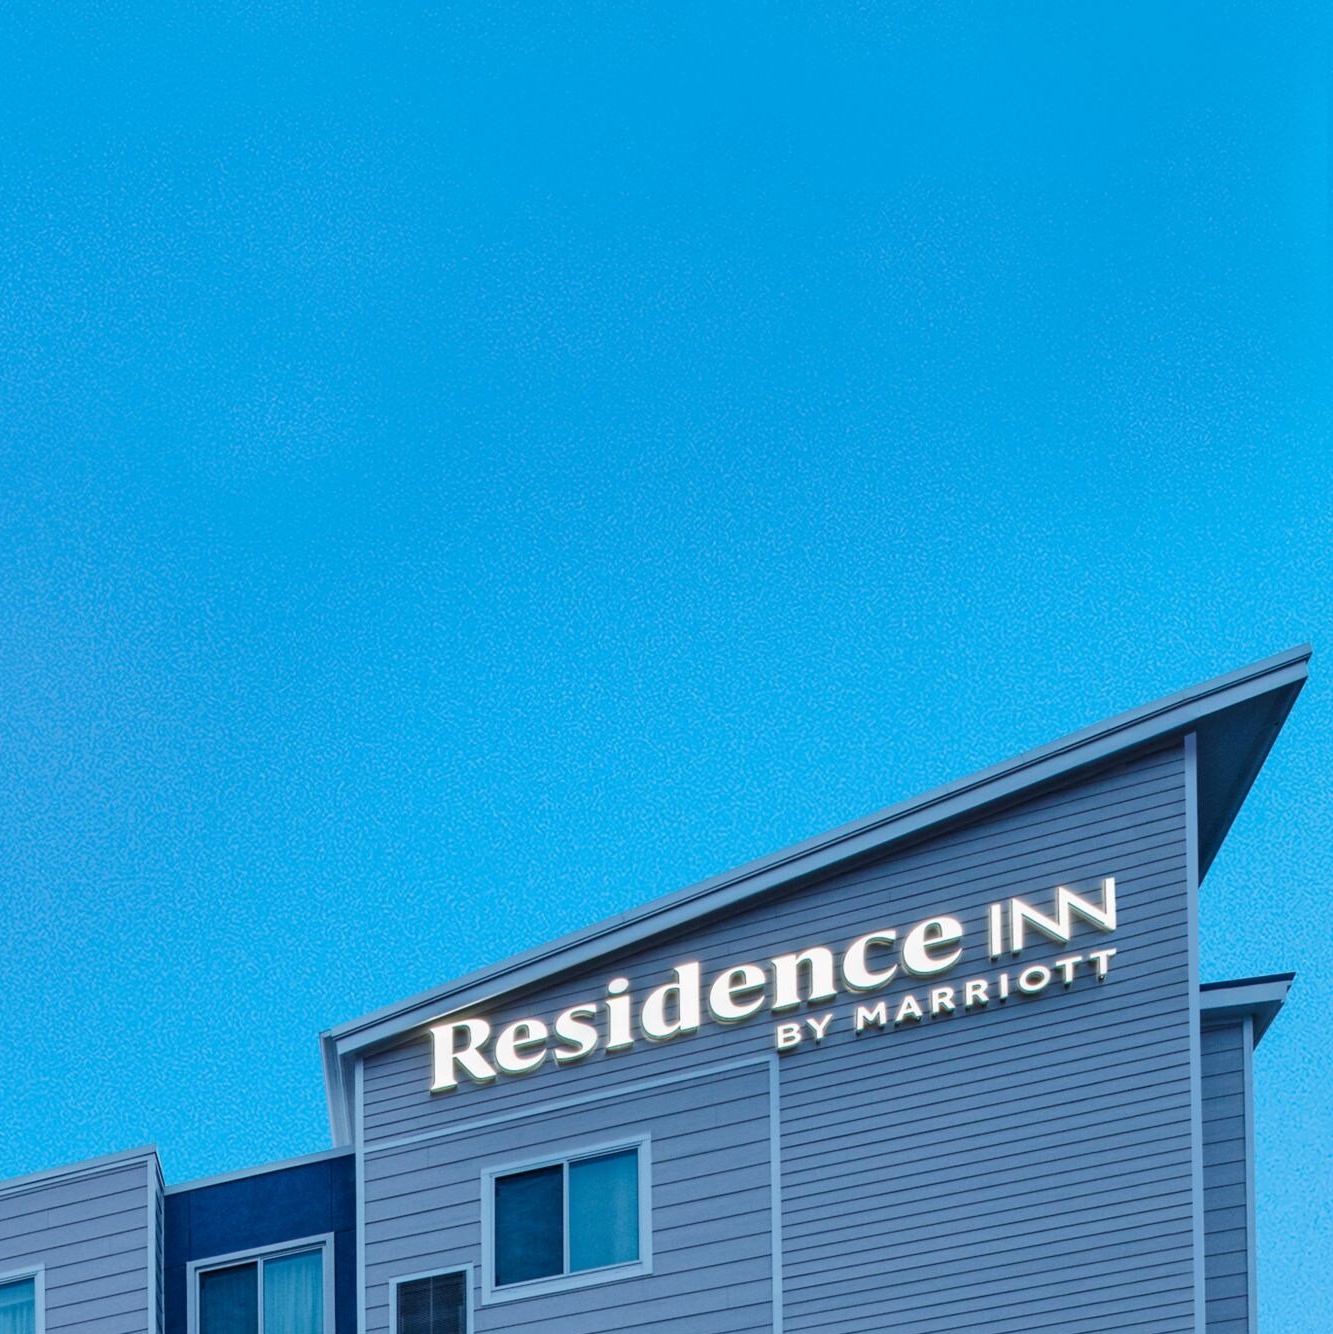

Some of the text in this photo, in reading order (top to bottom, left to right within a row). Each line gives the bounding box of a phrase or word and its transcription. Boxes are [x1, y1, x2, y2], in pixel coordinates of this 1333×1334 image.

[429, 877, 1117, 1093] Residence INN
[776, 948, 1117, 1049] BY MARRIOTT
